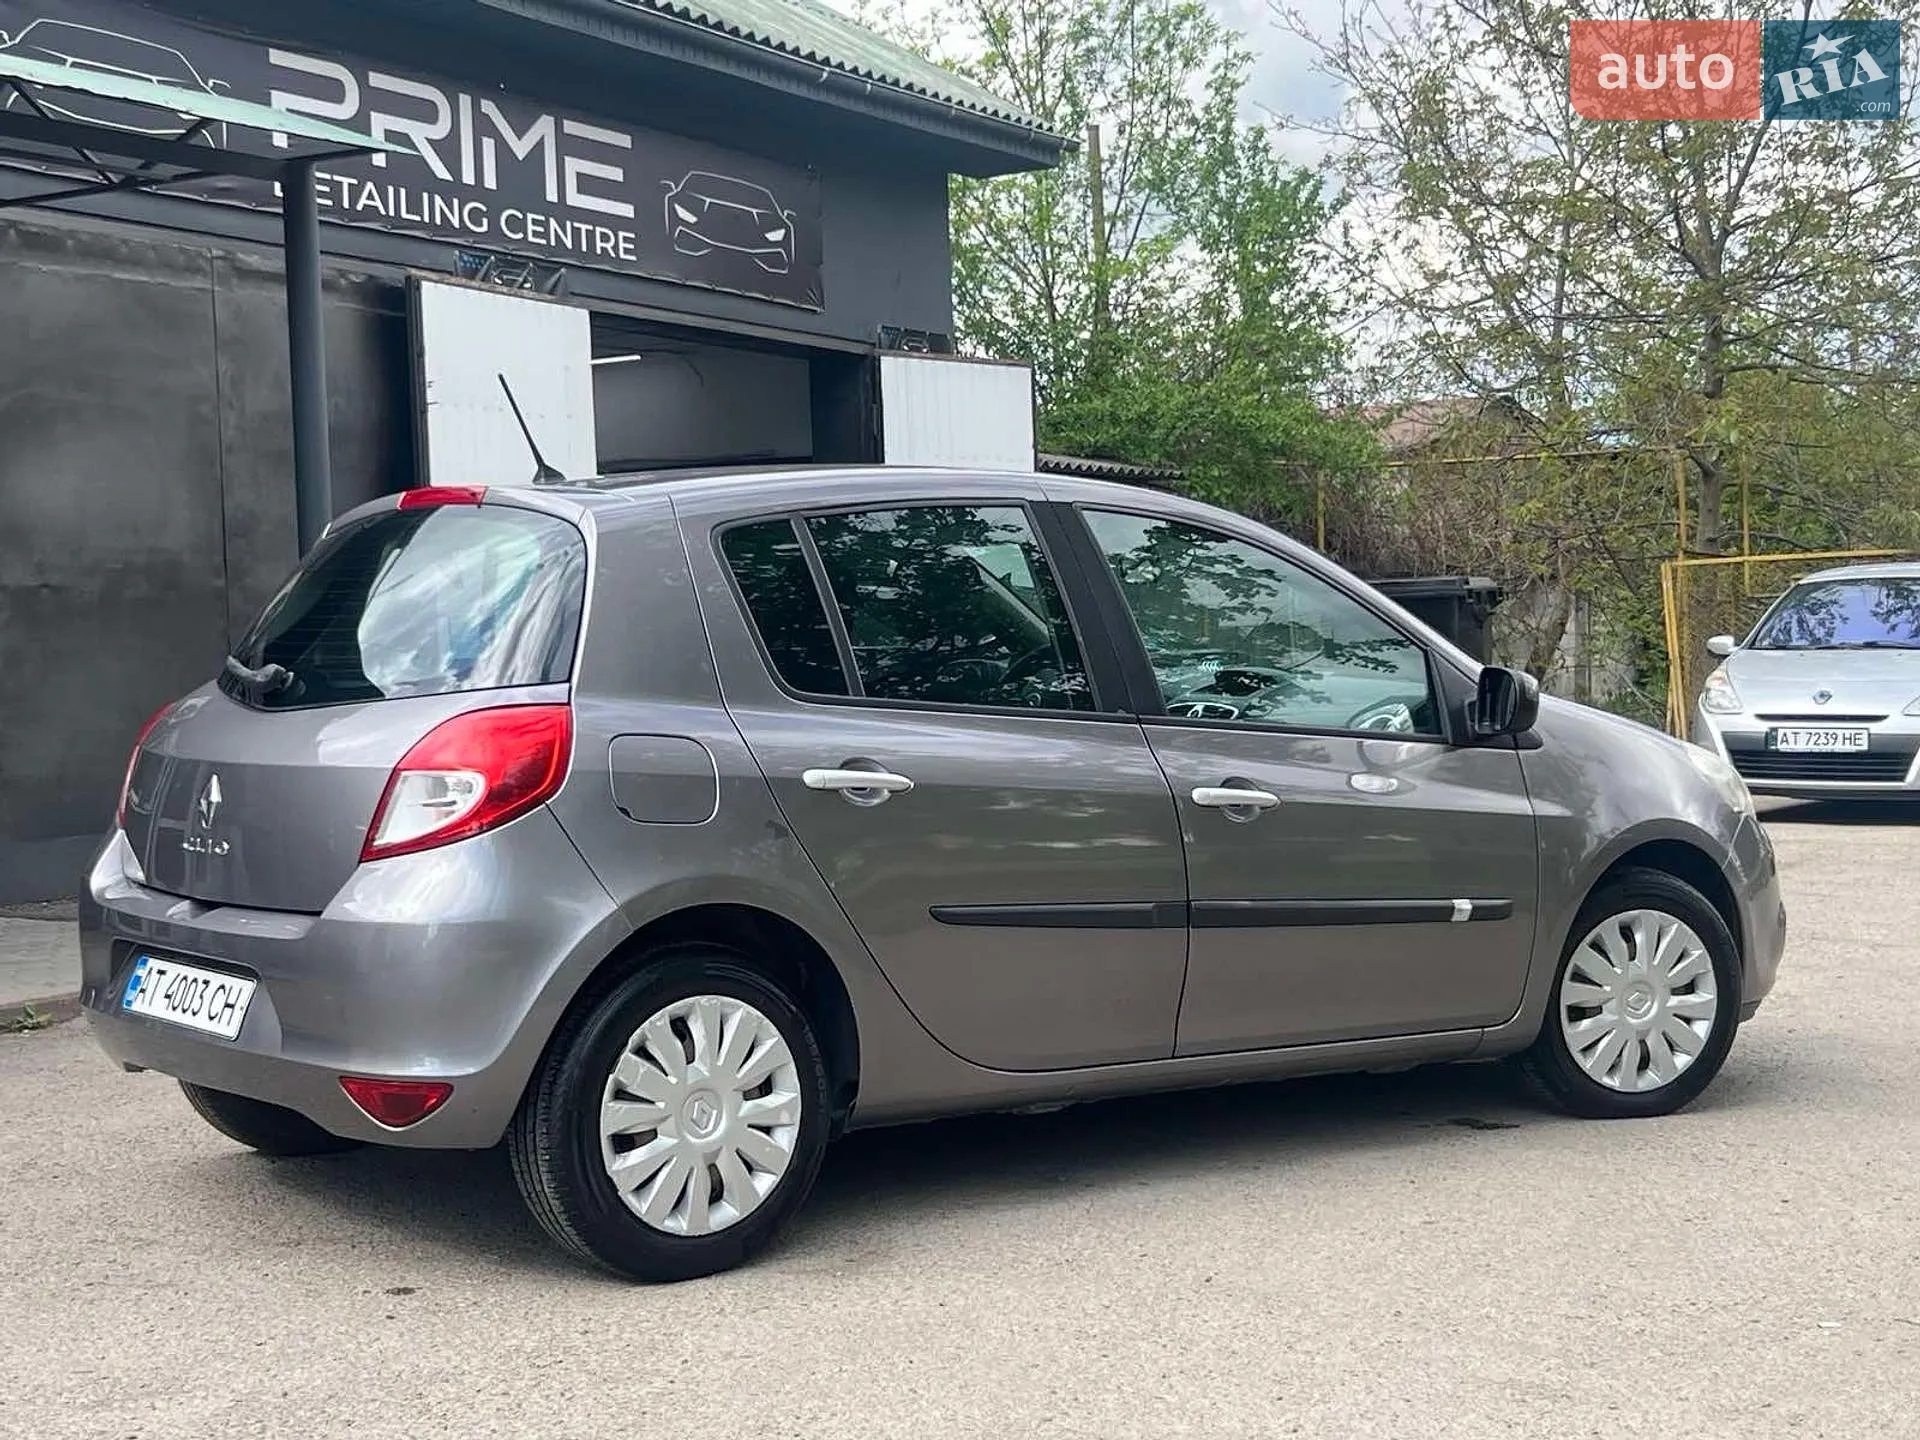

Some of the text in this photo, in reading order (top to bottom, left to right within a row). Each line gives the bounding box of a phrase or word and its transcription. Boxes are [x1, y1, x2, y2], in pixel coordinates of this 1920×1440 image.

[268, 47, 635, 219] PRIME
[500, 208, 637, 261] CENTRE
[1780, 731, 1864, 746] AT 7239 HE
[135, 966, 242, 1026] AT 4003 CH
